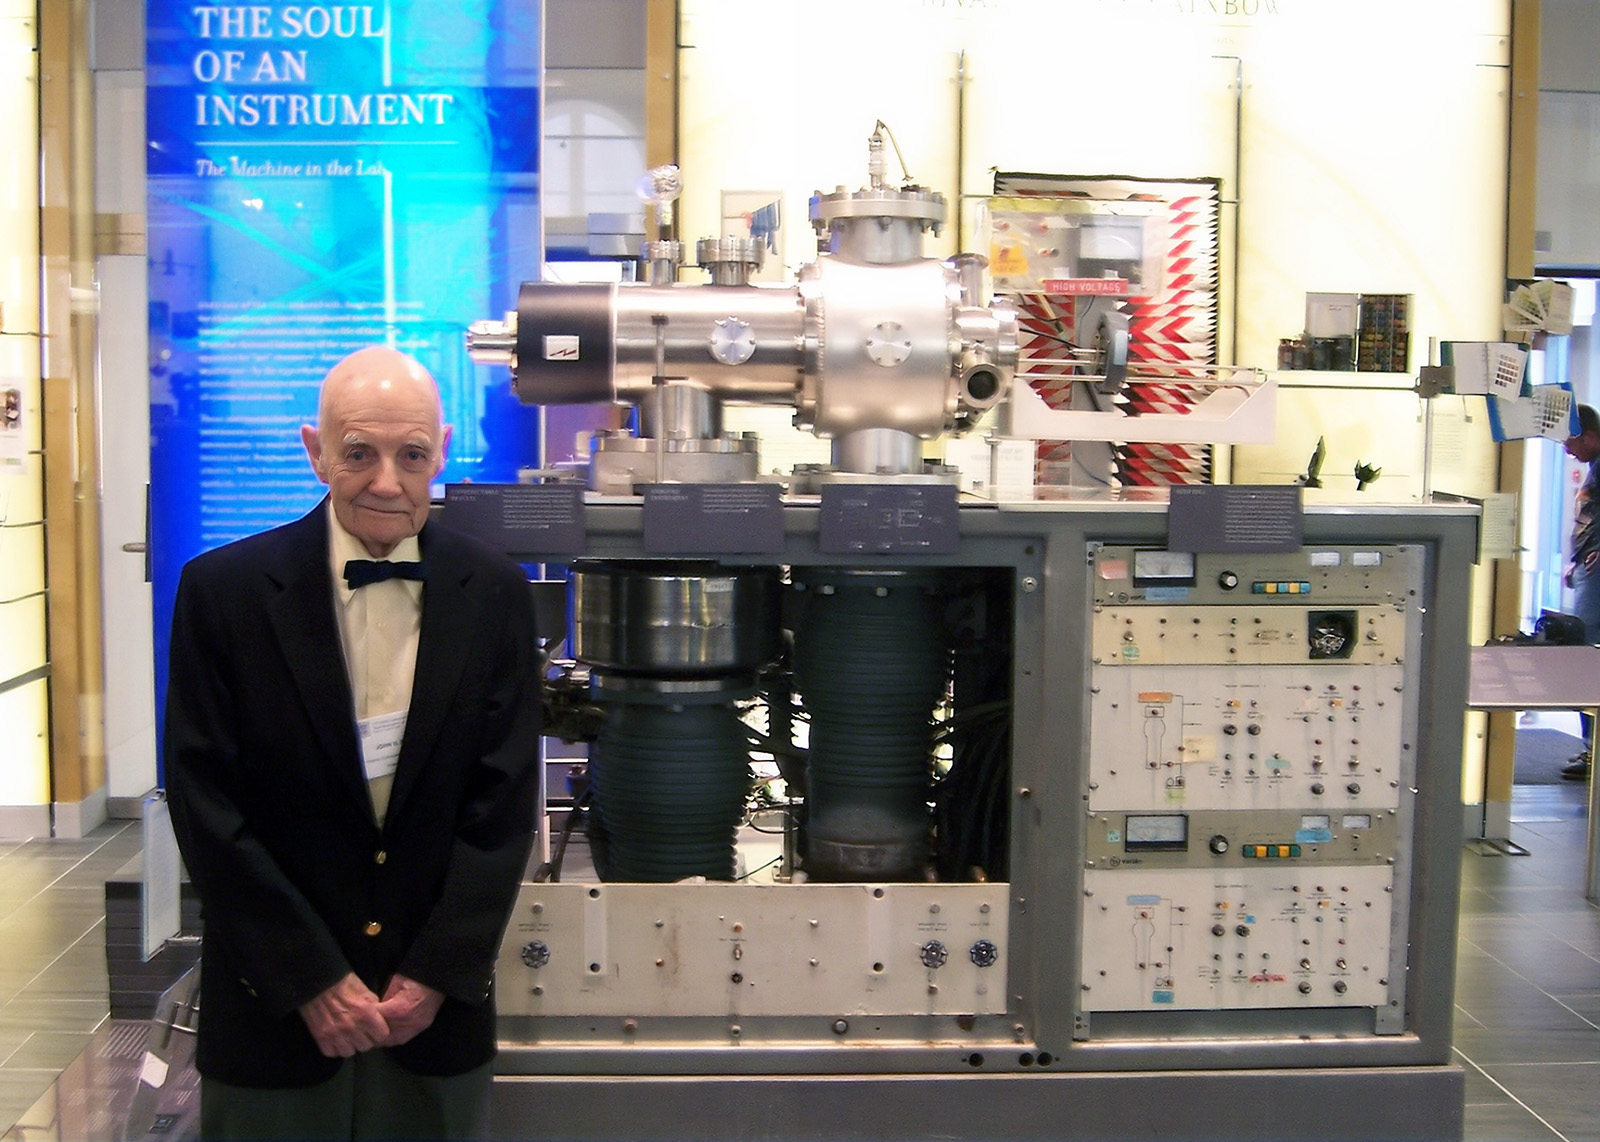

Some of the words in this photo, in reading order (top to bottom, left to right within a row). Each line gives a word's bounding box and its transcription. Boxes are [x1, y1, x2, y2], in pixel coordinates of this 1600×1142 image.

[194, 6, 273, 38] THE
[281, 5, 385, 38] SOUL
[194, 50, 245, 83] OF
[252, 50, 308, 82] AN
[195, 94, 454, 126] INSTRUMENT
[196, 159, 226, 177] The
[230, 157, 302, 177] Machine
[305, 160, 322, 177] in
[326, 159, 354, 177] the
[1052, 282, 1076, 292] HIGH
[1079, 282, 1121, 293] VOLTAGE
